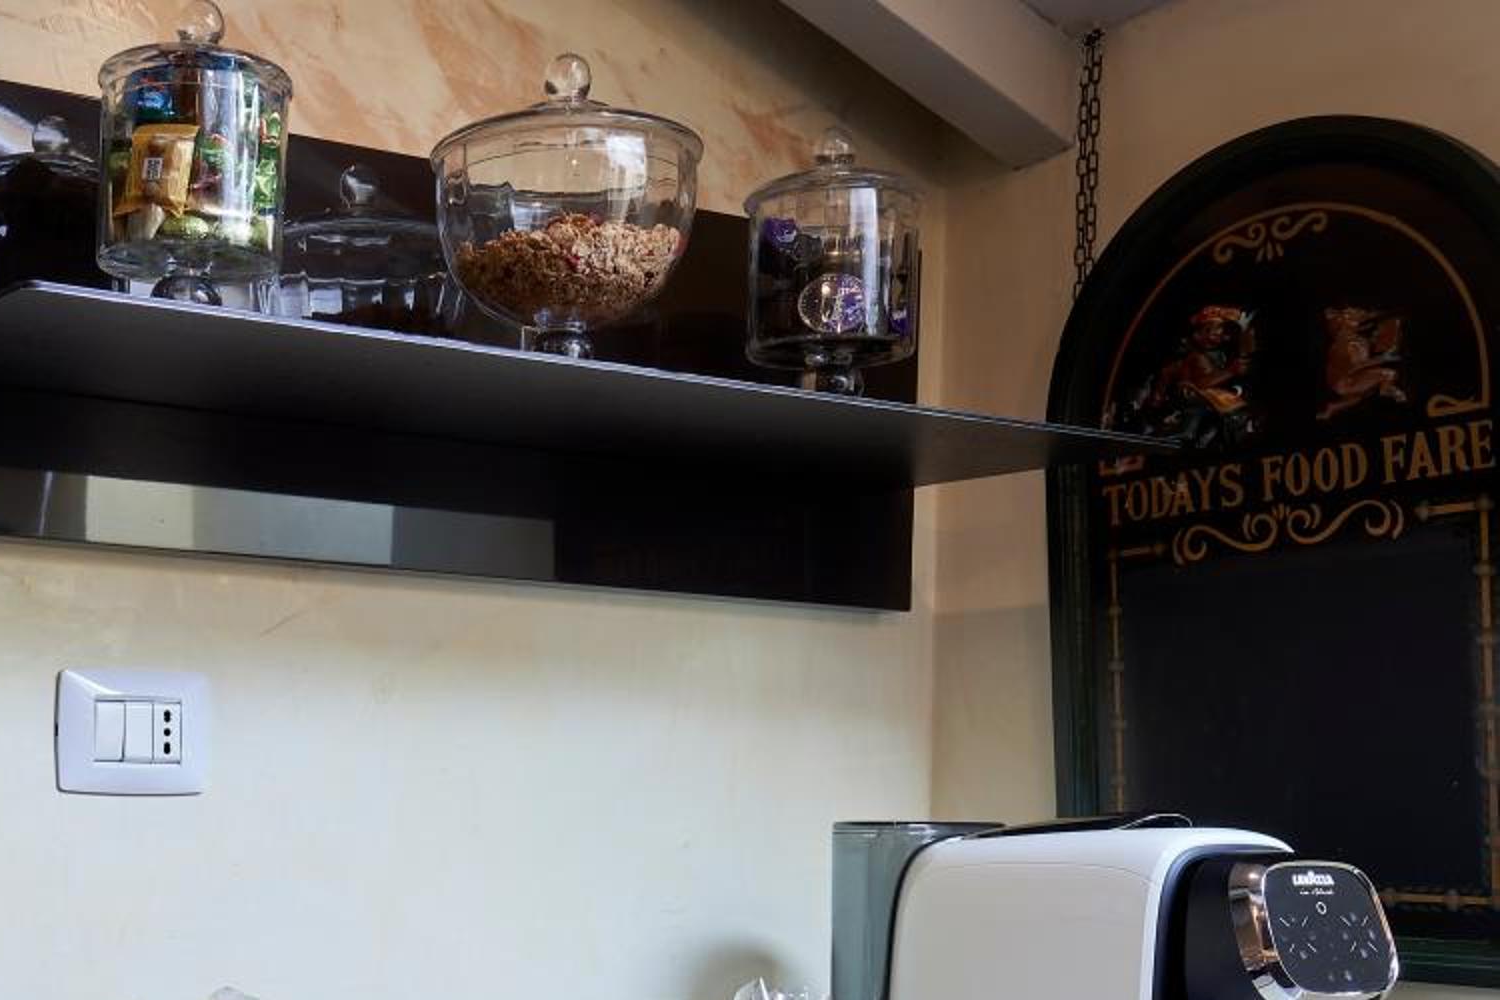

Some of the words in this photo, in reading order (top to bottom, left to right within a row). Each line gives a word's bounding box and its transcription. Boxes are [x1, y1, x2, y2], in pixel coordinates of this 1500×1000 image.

[1103, 463, 1243, 527] TODAYS
[1262, 443, 1368, 504] FOOD
[1380, 419, 1496, 485] FARE
